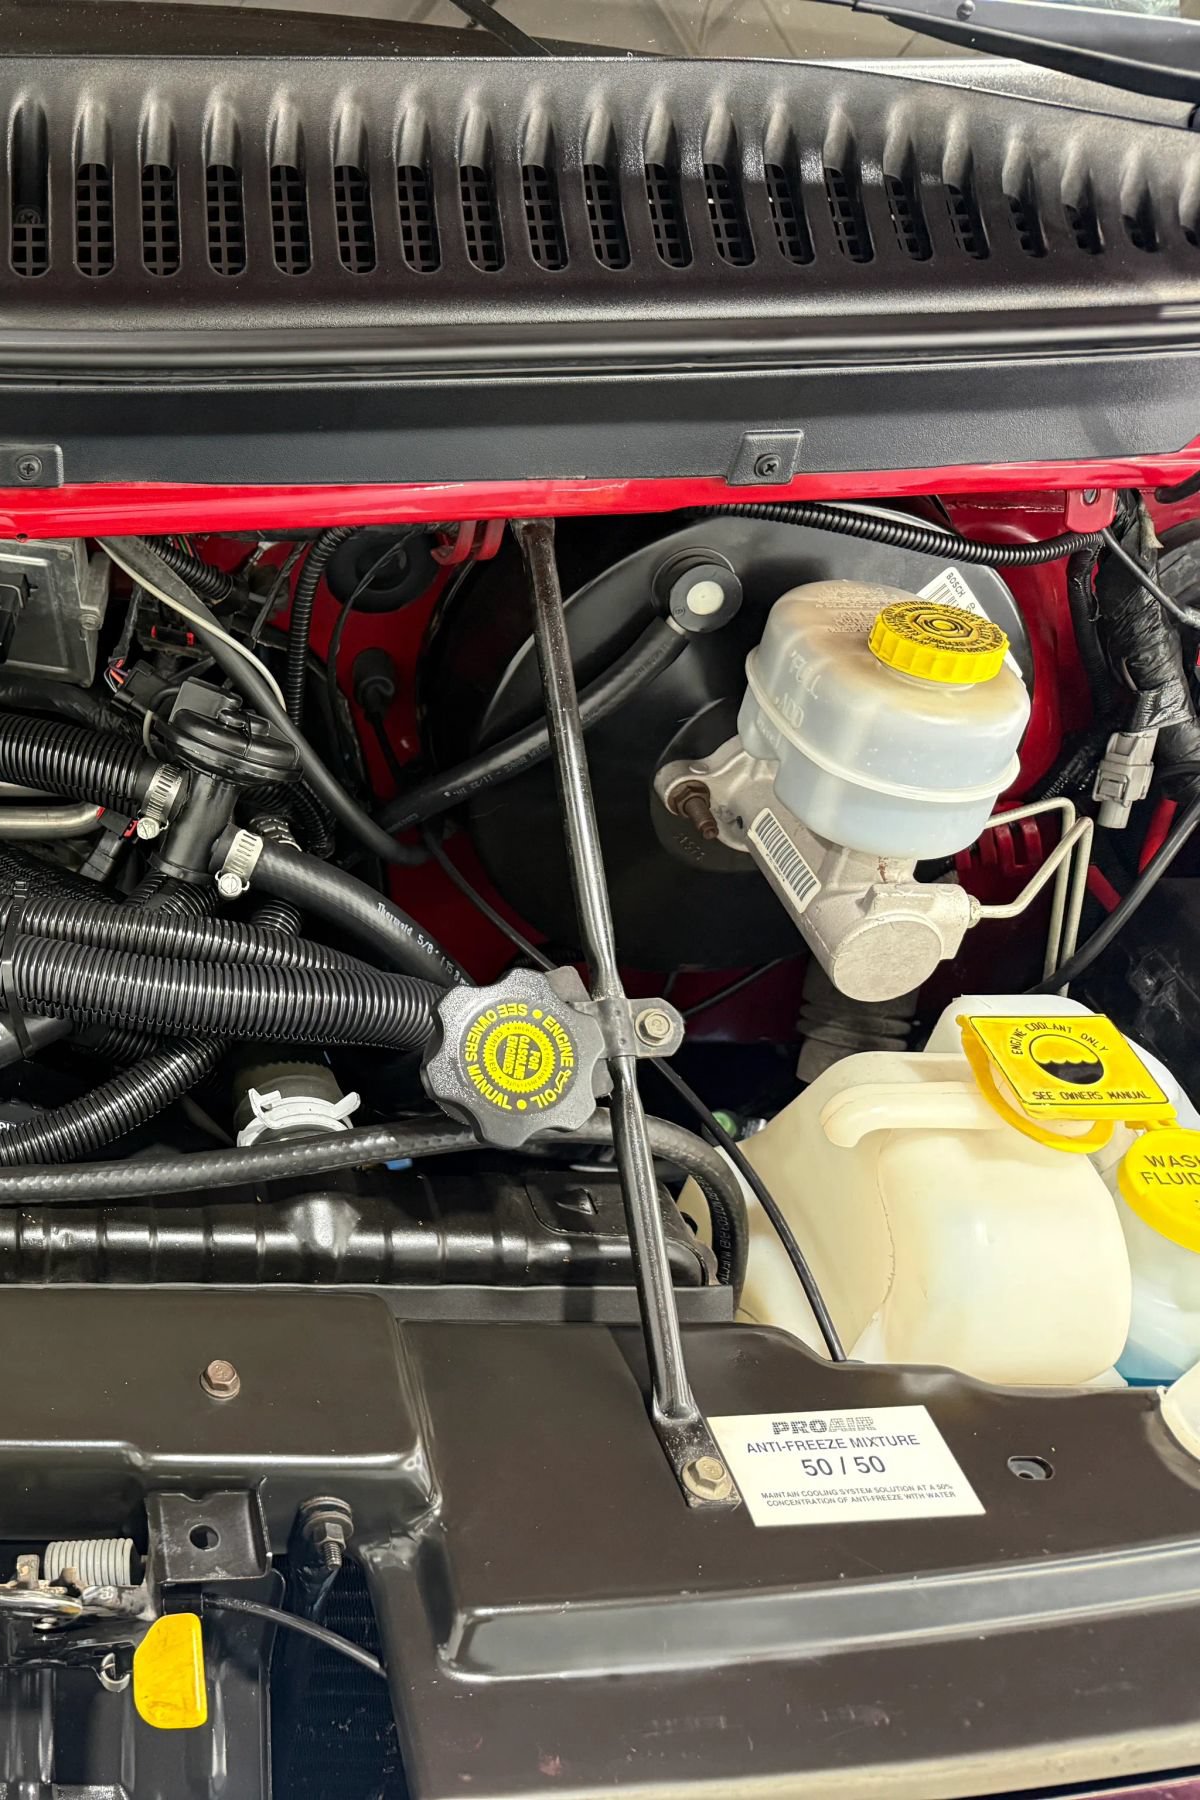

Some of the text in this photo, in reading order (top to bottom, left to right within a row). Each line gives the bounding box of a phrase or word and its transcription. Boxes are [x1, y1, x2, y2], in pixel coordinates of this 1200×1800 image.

[946, 572, 966, 598] BOSCH
[1011, 1021, 1109, 1056] ENGINE COOLANT ONLY
[464, 1003, 529, 1110] SEE OWNERS MANUAL
[488, 1031, 504, 1072] CERTIFIED
[528, 1050, 541, 1071] FOR
[529, 1014, 574, 1110] ENGINE OIL
[1032, 1090, 1151, 1100] SEE OWNERS MANUAL
[772, 1416, 877, 1435] PROAIR
[747, 1434, 920, 1454] ANTI-FREEZE MIXTURE
[801, 1455, 886, 1477] 50 / 50
[761, 1491, 800, 1499] MAINTAIN
[801, 1488, 839, 1497] COOLING
[839, 1487, 873, 1496] SYSTEM
[874, 1485, 915, 1494] SOLUTION
[917, 1484, 927, 1492] AT
[766, 1491, 957, 1507] CONCENTRATION OF ANTI-FREEZE WITH WATER
